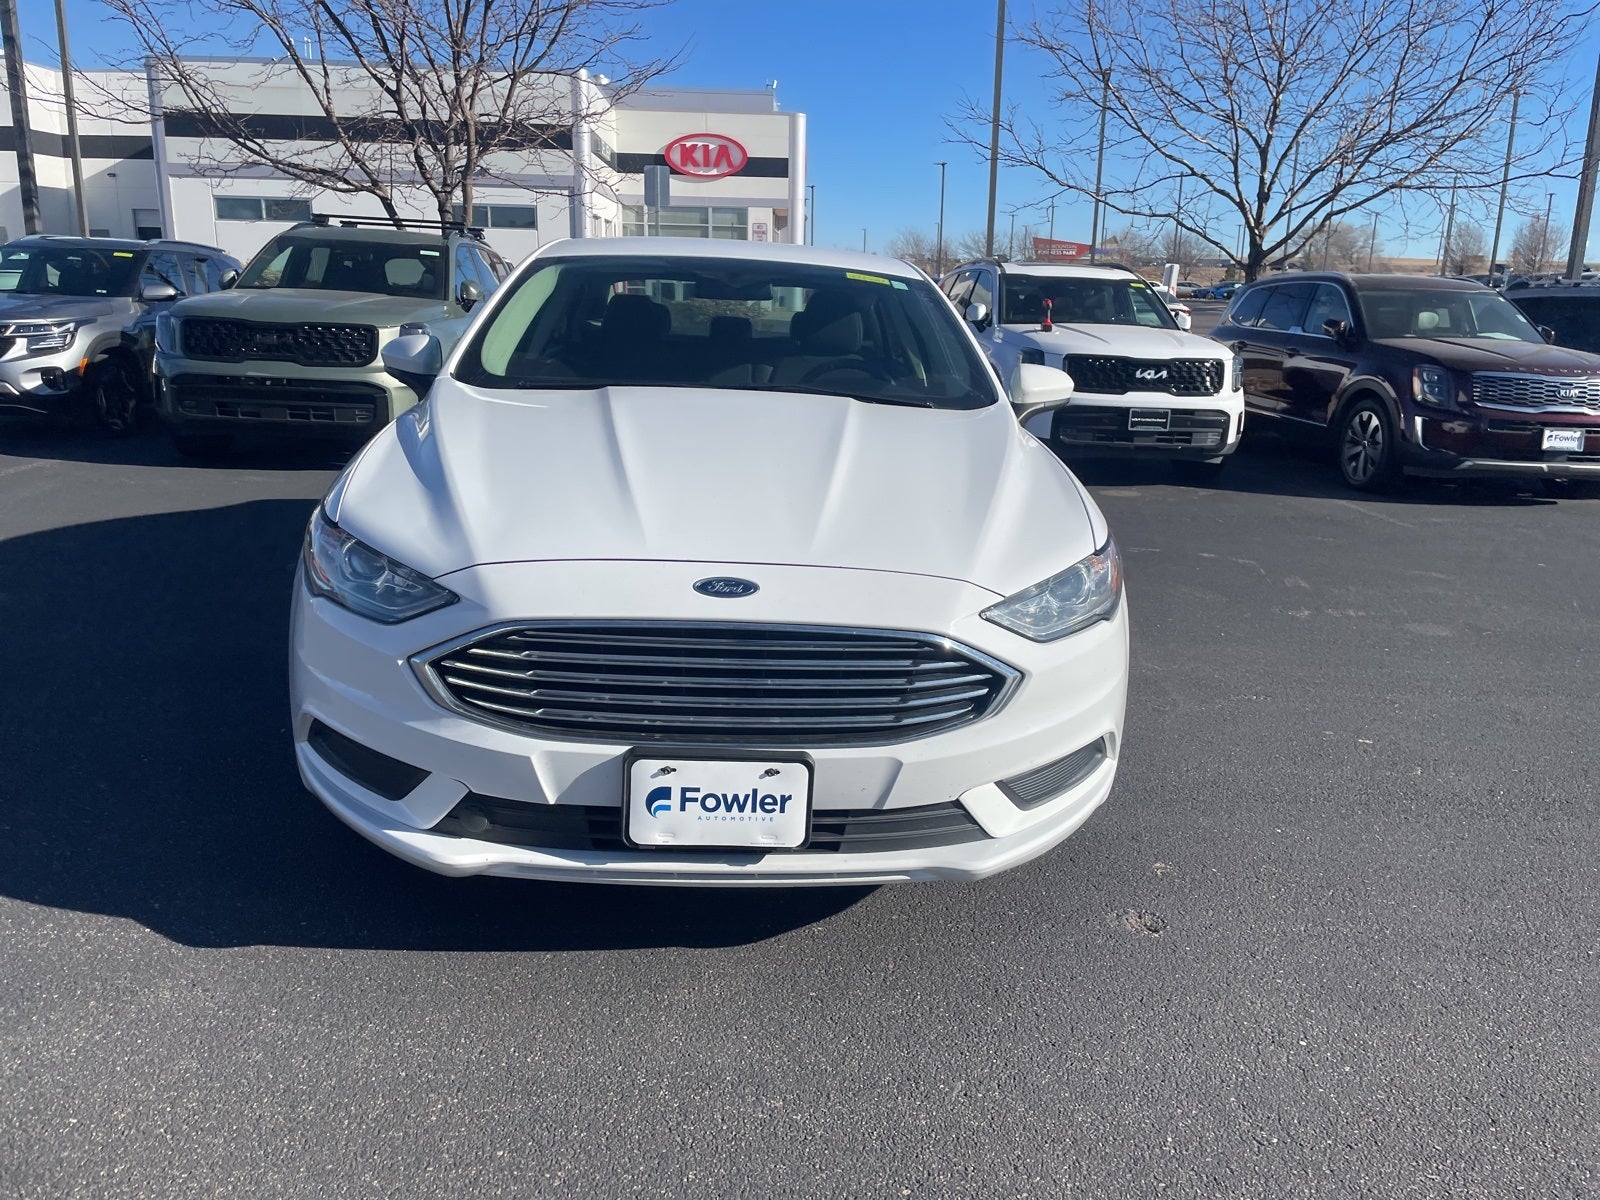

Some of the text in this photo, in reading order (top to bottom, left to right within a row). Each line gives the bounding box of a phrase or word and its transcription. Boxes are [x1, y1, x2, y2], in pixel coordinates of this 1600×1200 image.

[679, 143, 735, 168] KIA
[1560, 389, 1575, 397] KIA
[1554, 434, 1580, 442] Fowler
[679, 786, 793, 814] Fowler
